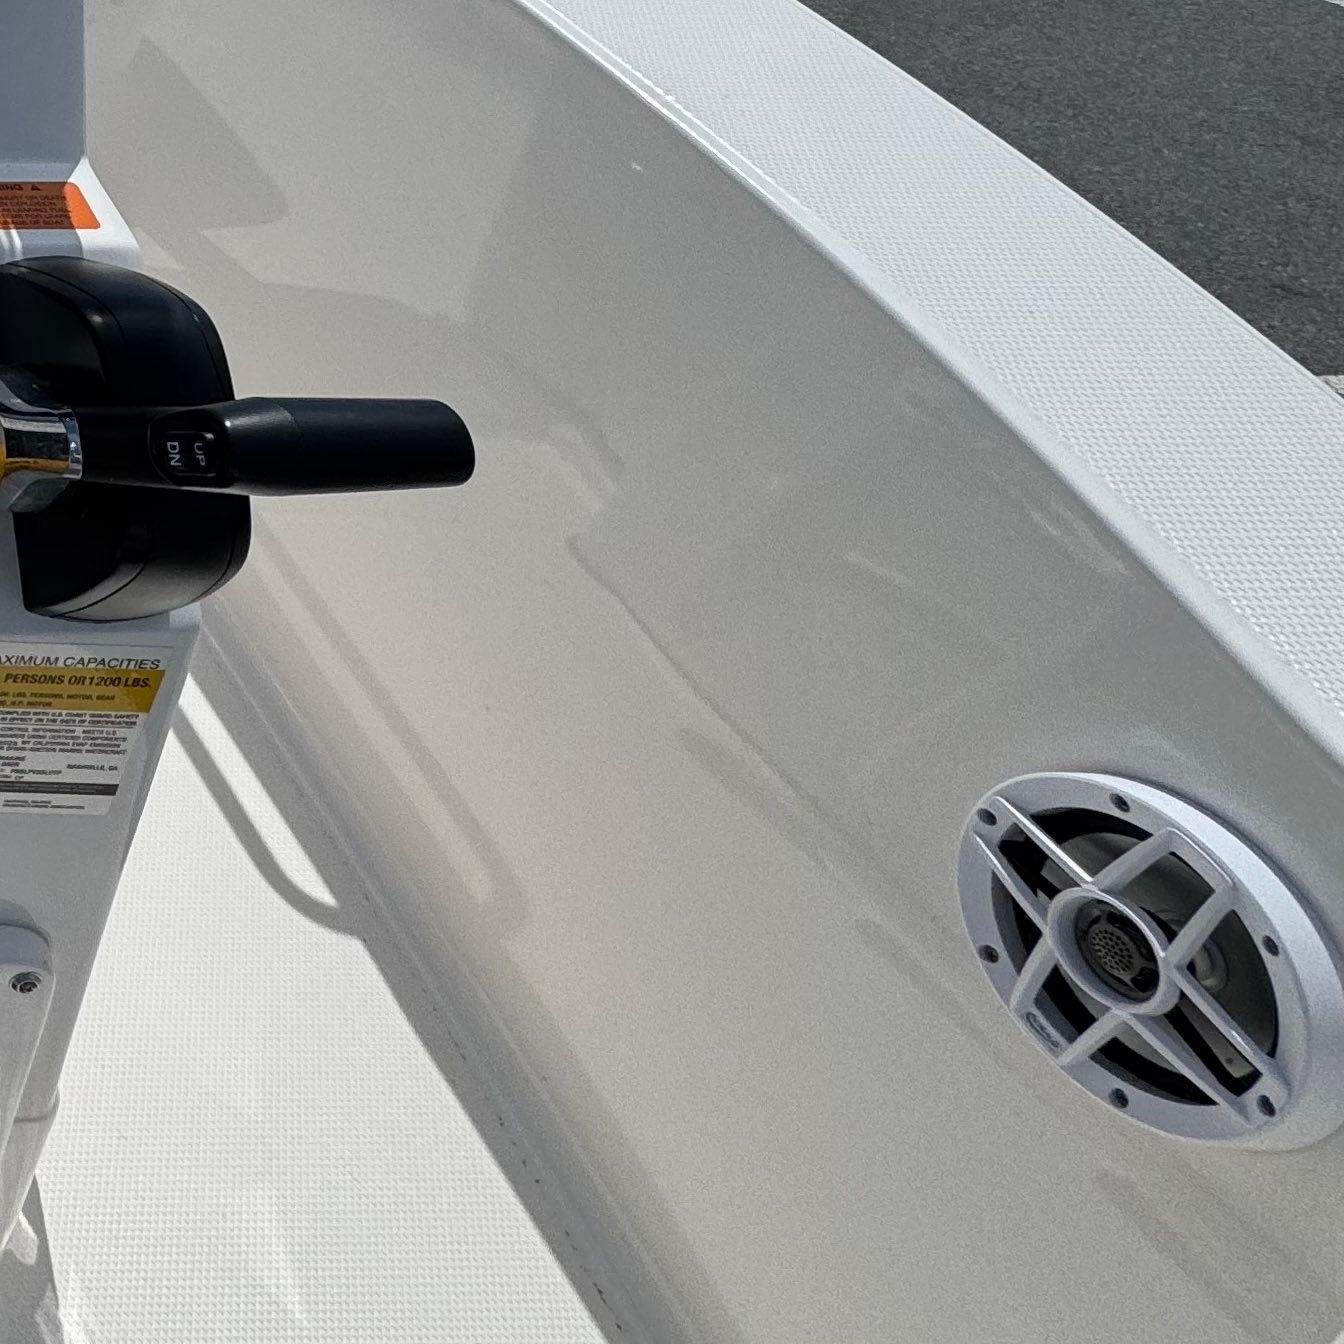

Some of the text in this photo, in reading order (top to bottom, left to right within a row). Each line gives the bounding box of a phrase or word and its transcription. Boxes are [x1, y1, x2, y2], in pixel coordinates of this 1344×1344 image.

[166, 441, 182, 467] DN
[193, 441, 206, 467] UP
[64, 656, 161, 670] CAPACITIES
[4, 673, 65, 685] PERSONS
[123, 676, 151, 688] LBS.
